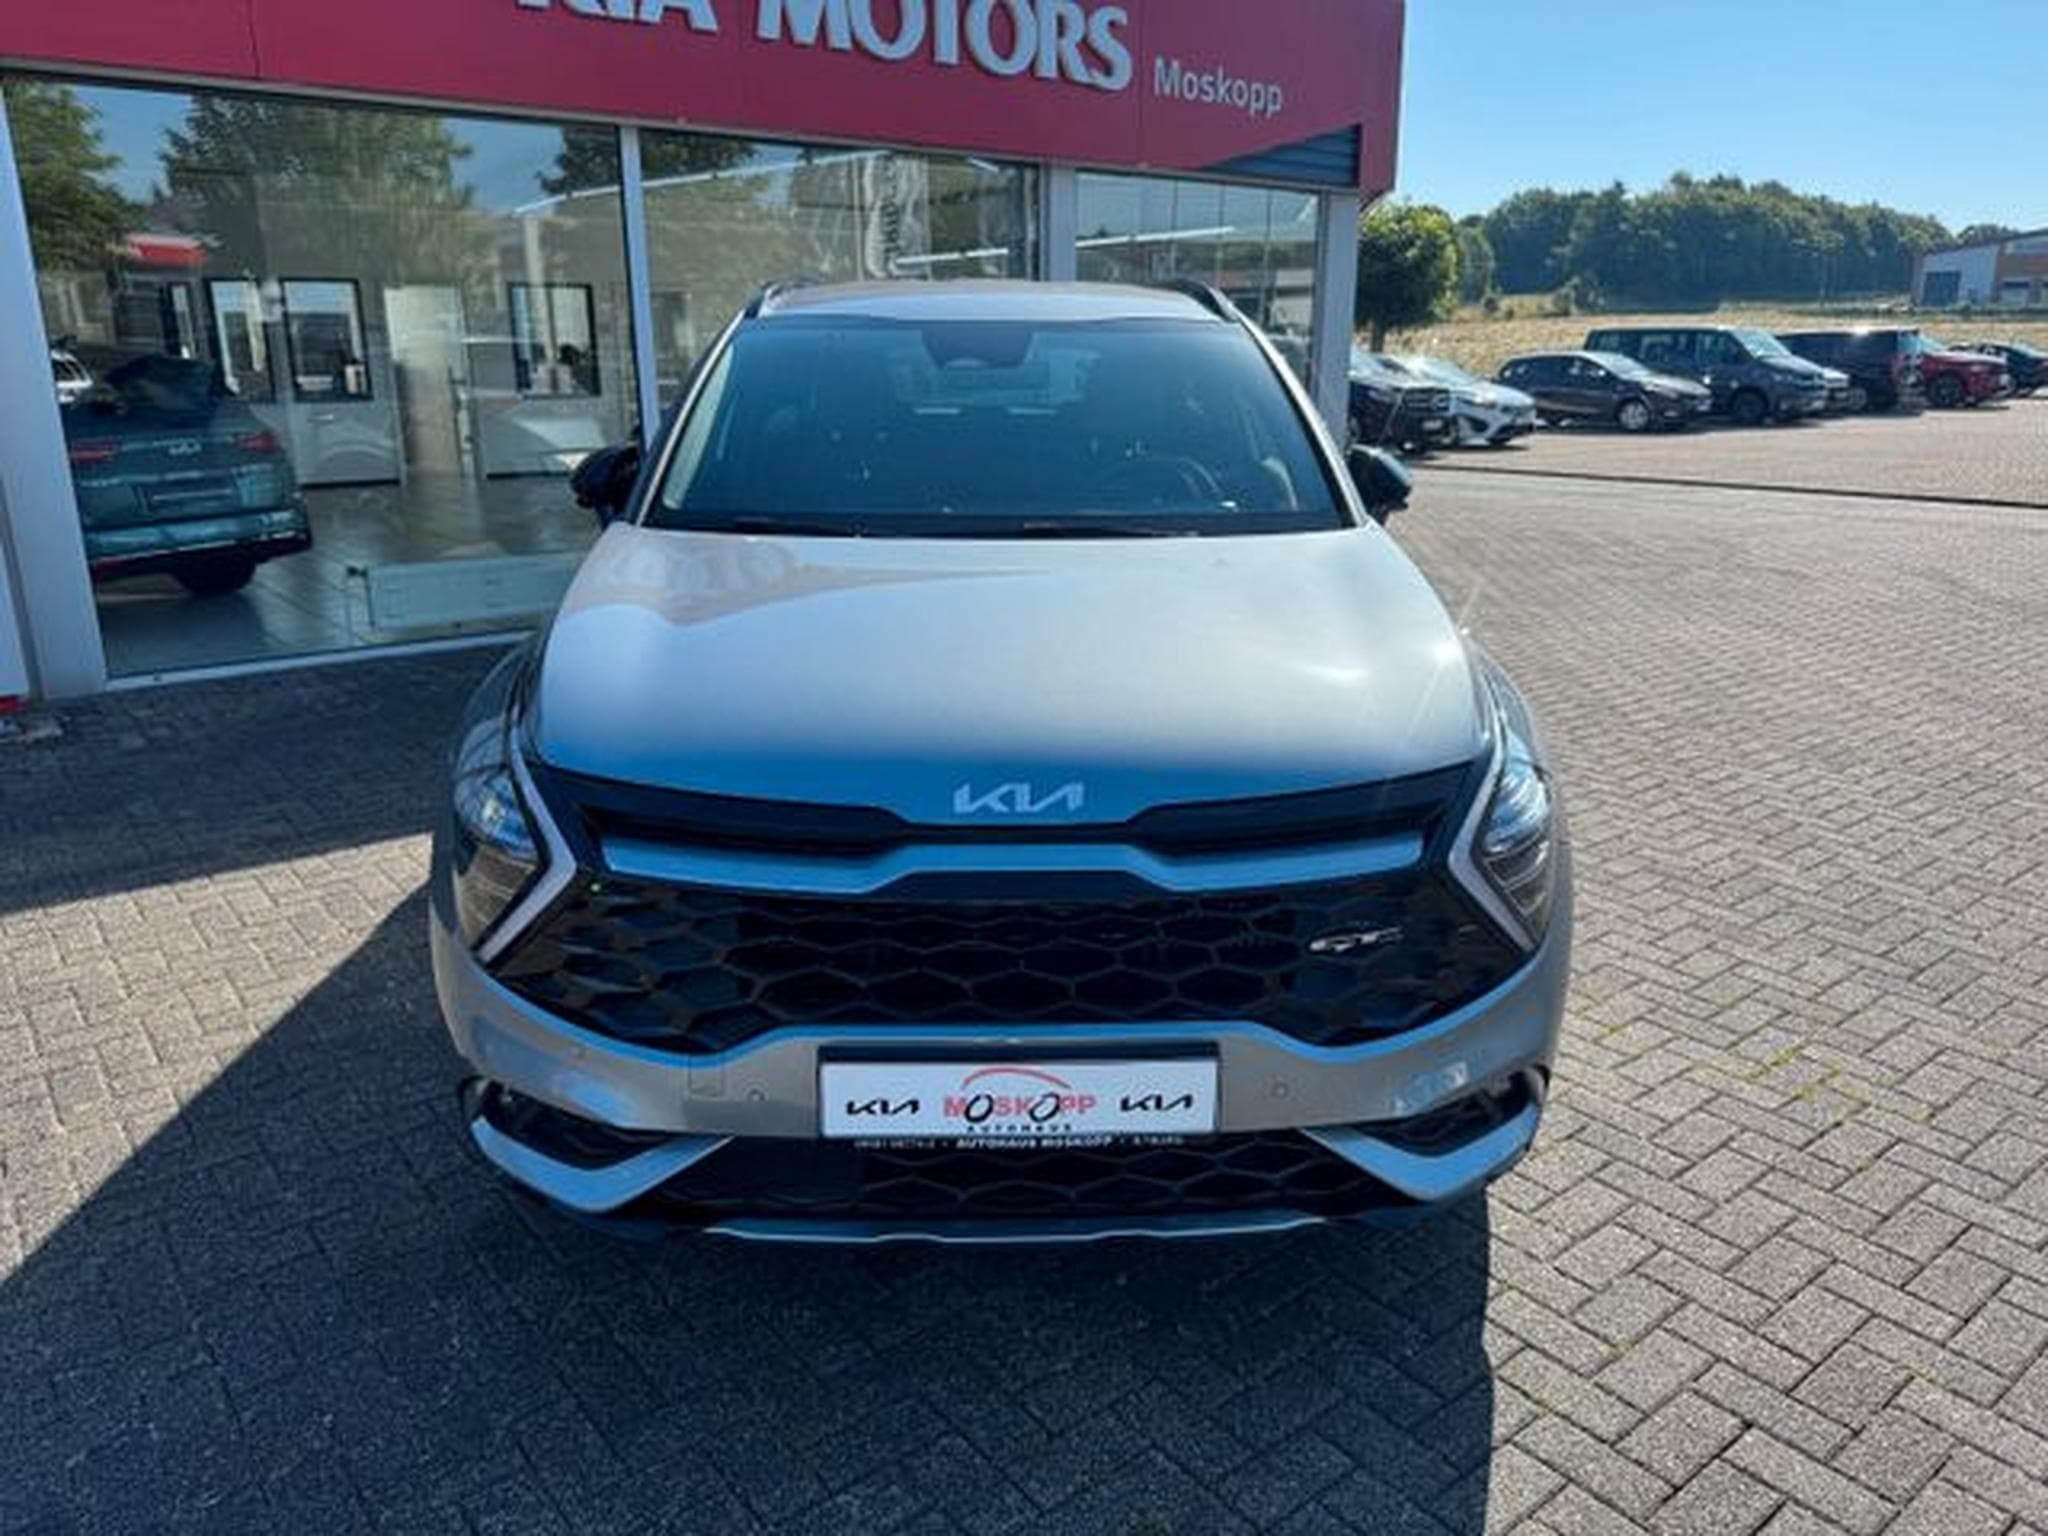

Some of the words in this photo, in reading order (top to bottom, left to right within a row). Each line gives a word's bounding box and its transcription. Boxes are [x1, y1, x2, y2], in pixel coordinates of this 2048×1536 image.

[1153, 56, 1283, 117] Moskopp
[953, 782, 1085, 813] KIA
[846, 1099, 920, 1115] KIA
[943, 1092, 1097, 1123] MOSKOPP
[1120, 1094, 1194, 1112] KIA
